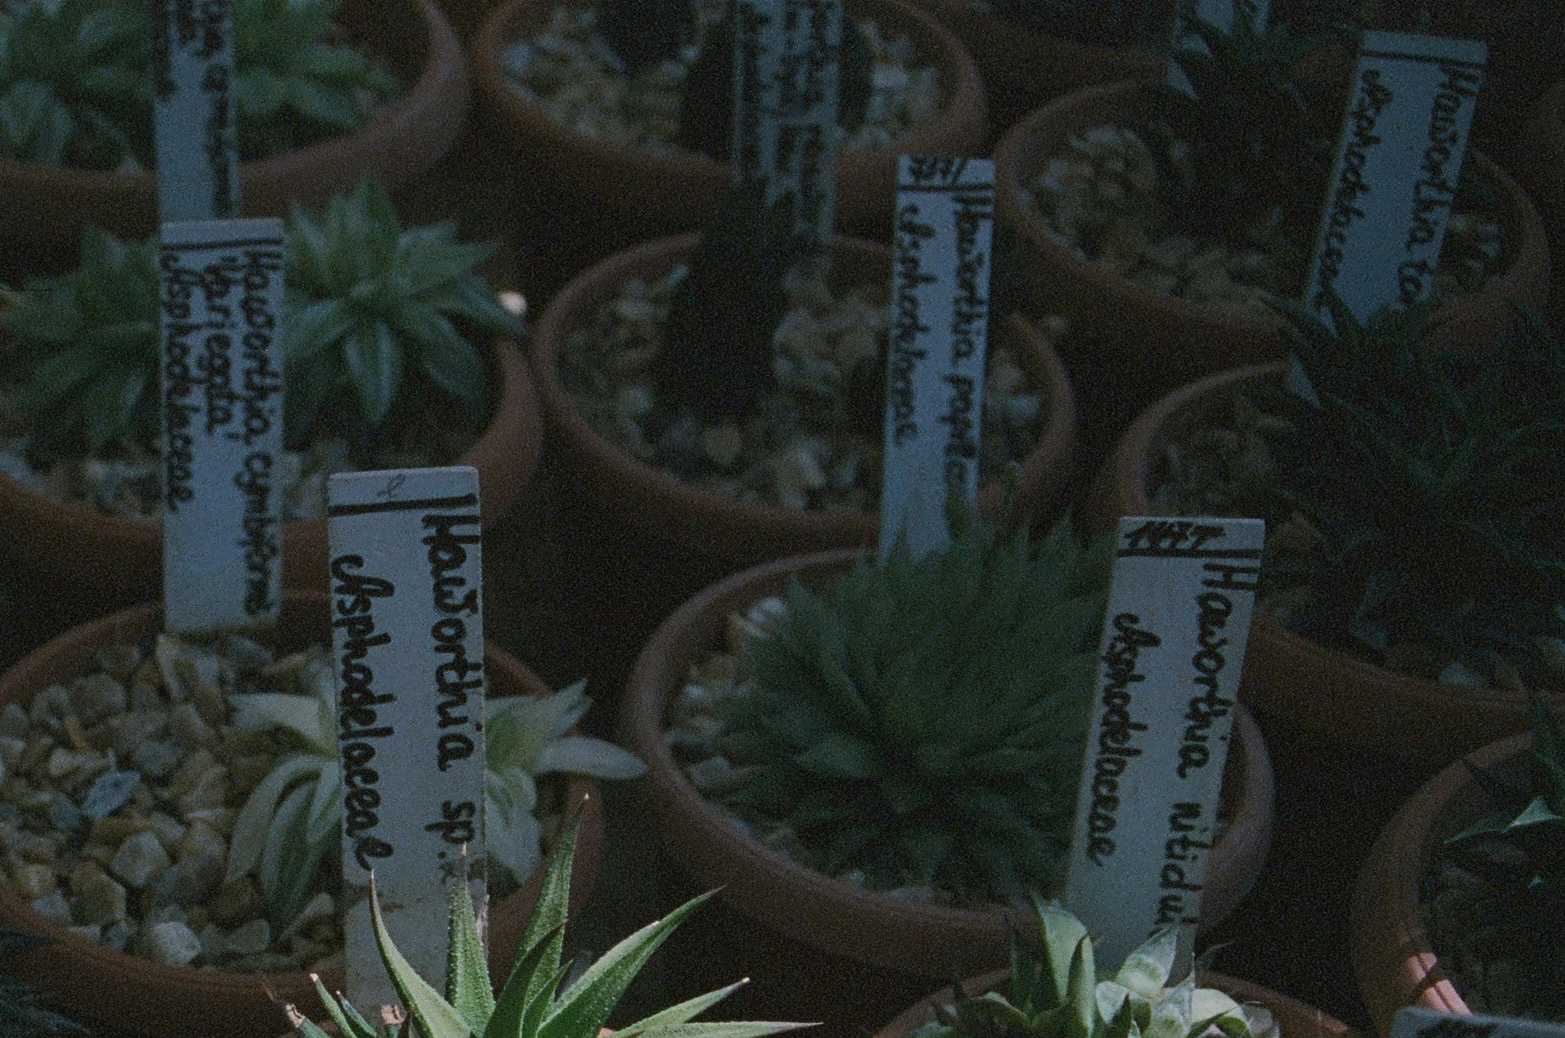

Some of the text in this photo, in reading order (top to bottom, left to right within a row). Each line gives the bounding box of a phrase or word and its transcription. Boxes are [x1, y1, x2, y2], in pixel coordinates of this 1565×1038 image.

[242, 252, 281, 445] Haworthia
[332, 556, 395, 871] Asphodelaceae
[421, 515, 482, 771] Haworthia
[1086, 613, 1161, 867] Asphodelaceae
[1147, 563, 1258, 938] Haworthia nitidul
